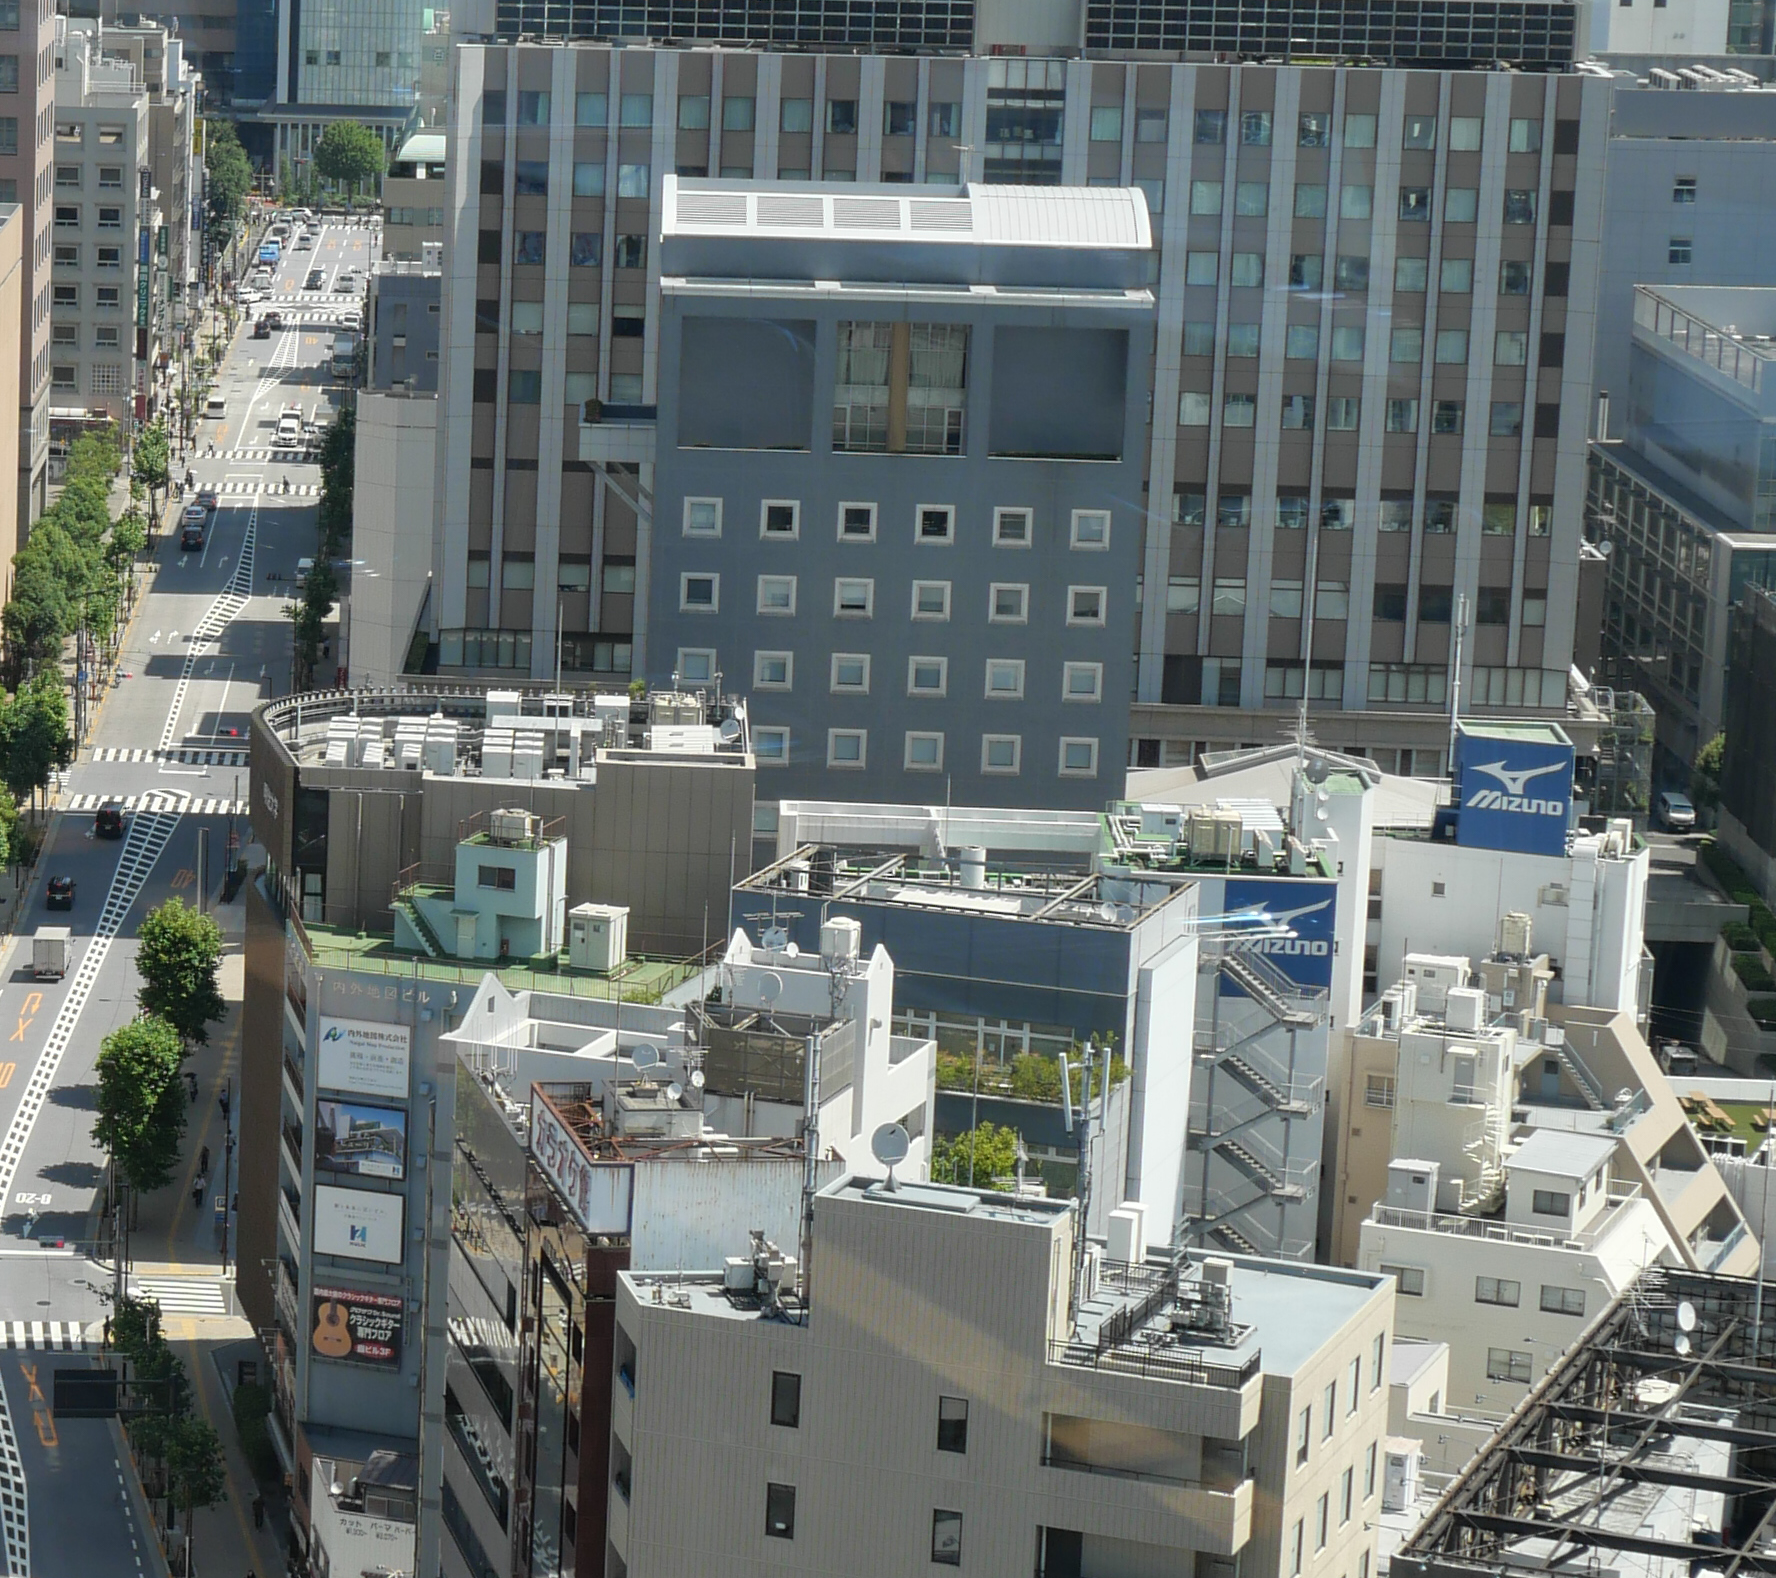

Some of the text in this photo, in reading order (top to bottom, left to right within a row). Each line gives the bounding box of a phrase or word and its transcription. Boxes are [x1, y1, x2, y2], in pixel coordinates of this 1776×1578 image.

[1466, 789, 1564, 816] MIZUNO
[1227, 933, 1328, 956] MIZUNO
[333, 981, 430, 1003] 内外地図ビル
[15, 1192, 52, 1205] 8-20
[349, 1313, 401, 1329] クラシックギター
[356, 1327, 392, 1342] 専門フロア
